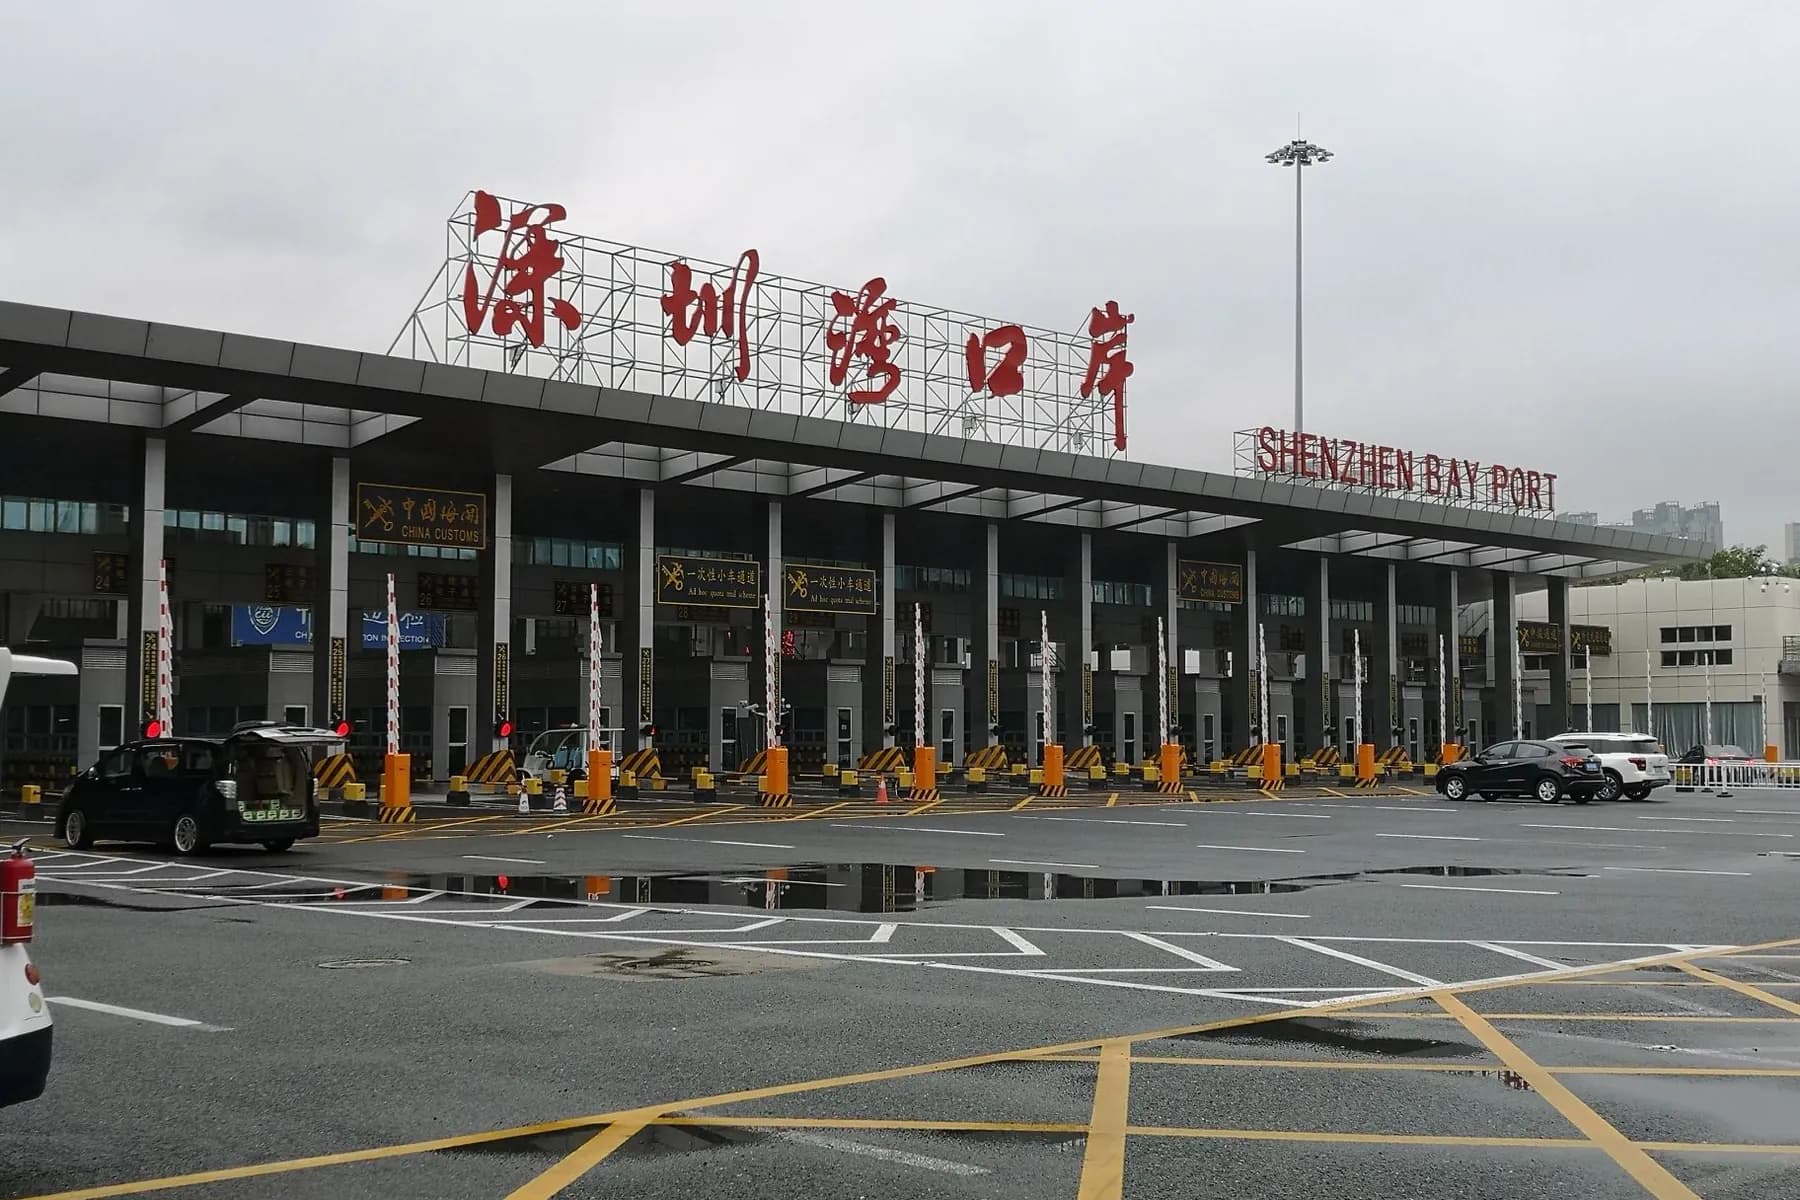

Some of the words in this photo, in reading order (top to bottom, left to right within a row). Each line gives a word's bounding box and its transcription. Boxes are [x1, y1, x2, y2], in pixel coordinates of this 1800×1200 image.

[1257, 426, 1413, 491] SHENZHEN
[1425, 454, 1479, 500] BAY
[1493, 464, 1557, 511] PORT
[402, 525, 430, 540] CHINA
[435, 528, 479, 542] CUSTOMS
[96, 575, 111, 590] 24
[145, 643, 156, 651] 24
[333, 648, 343, 656] 25
